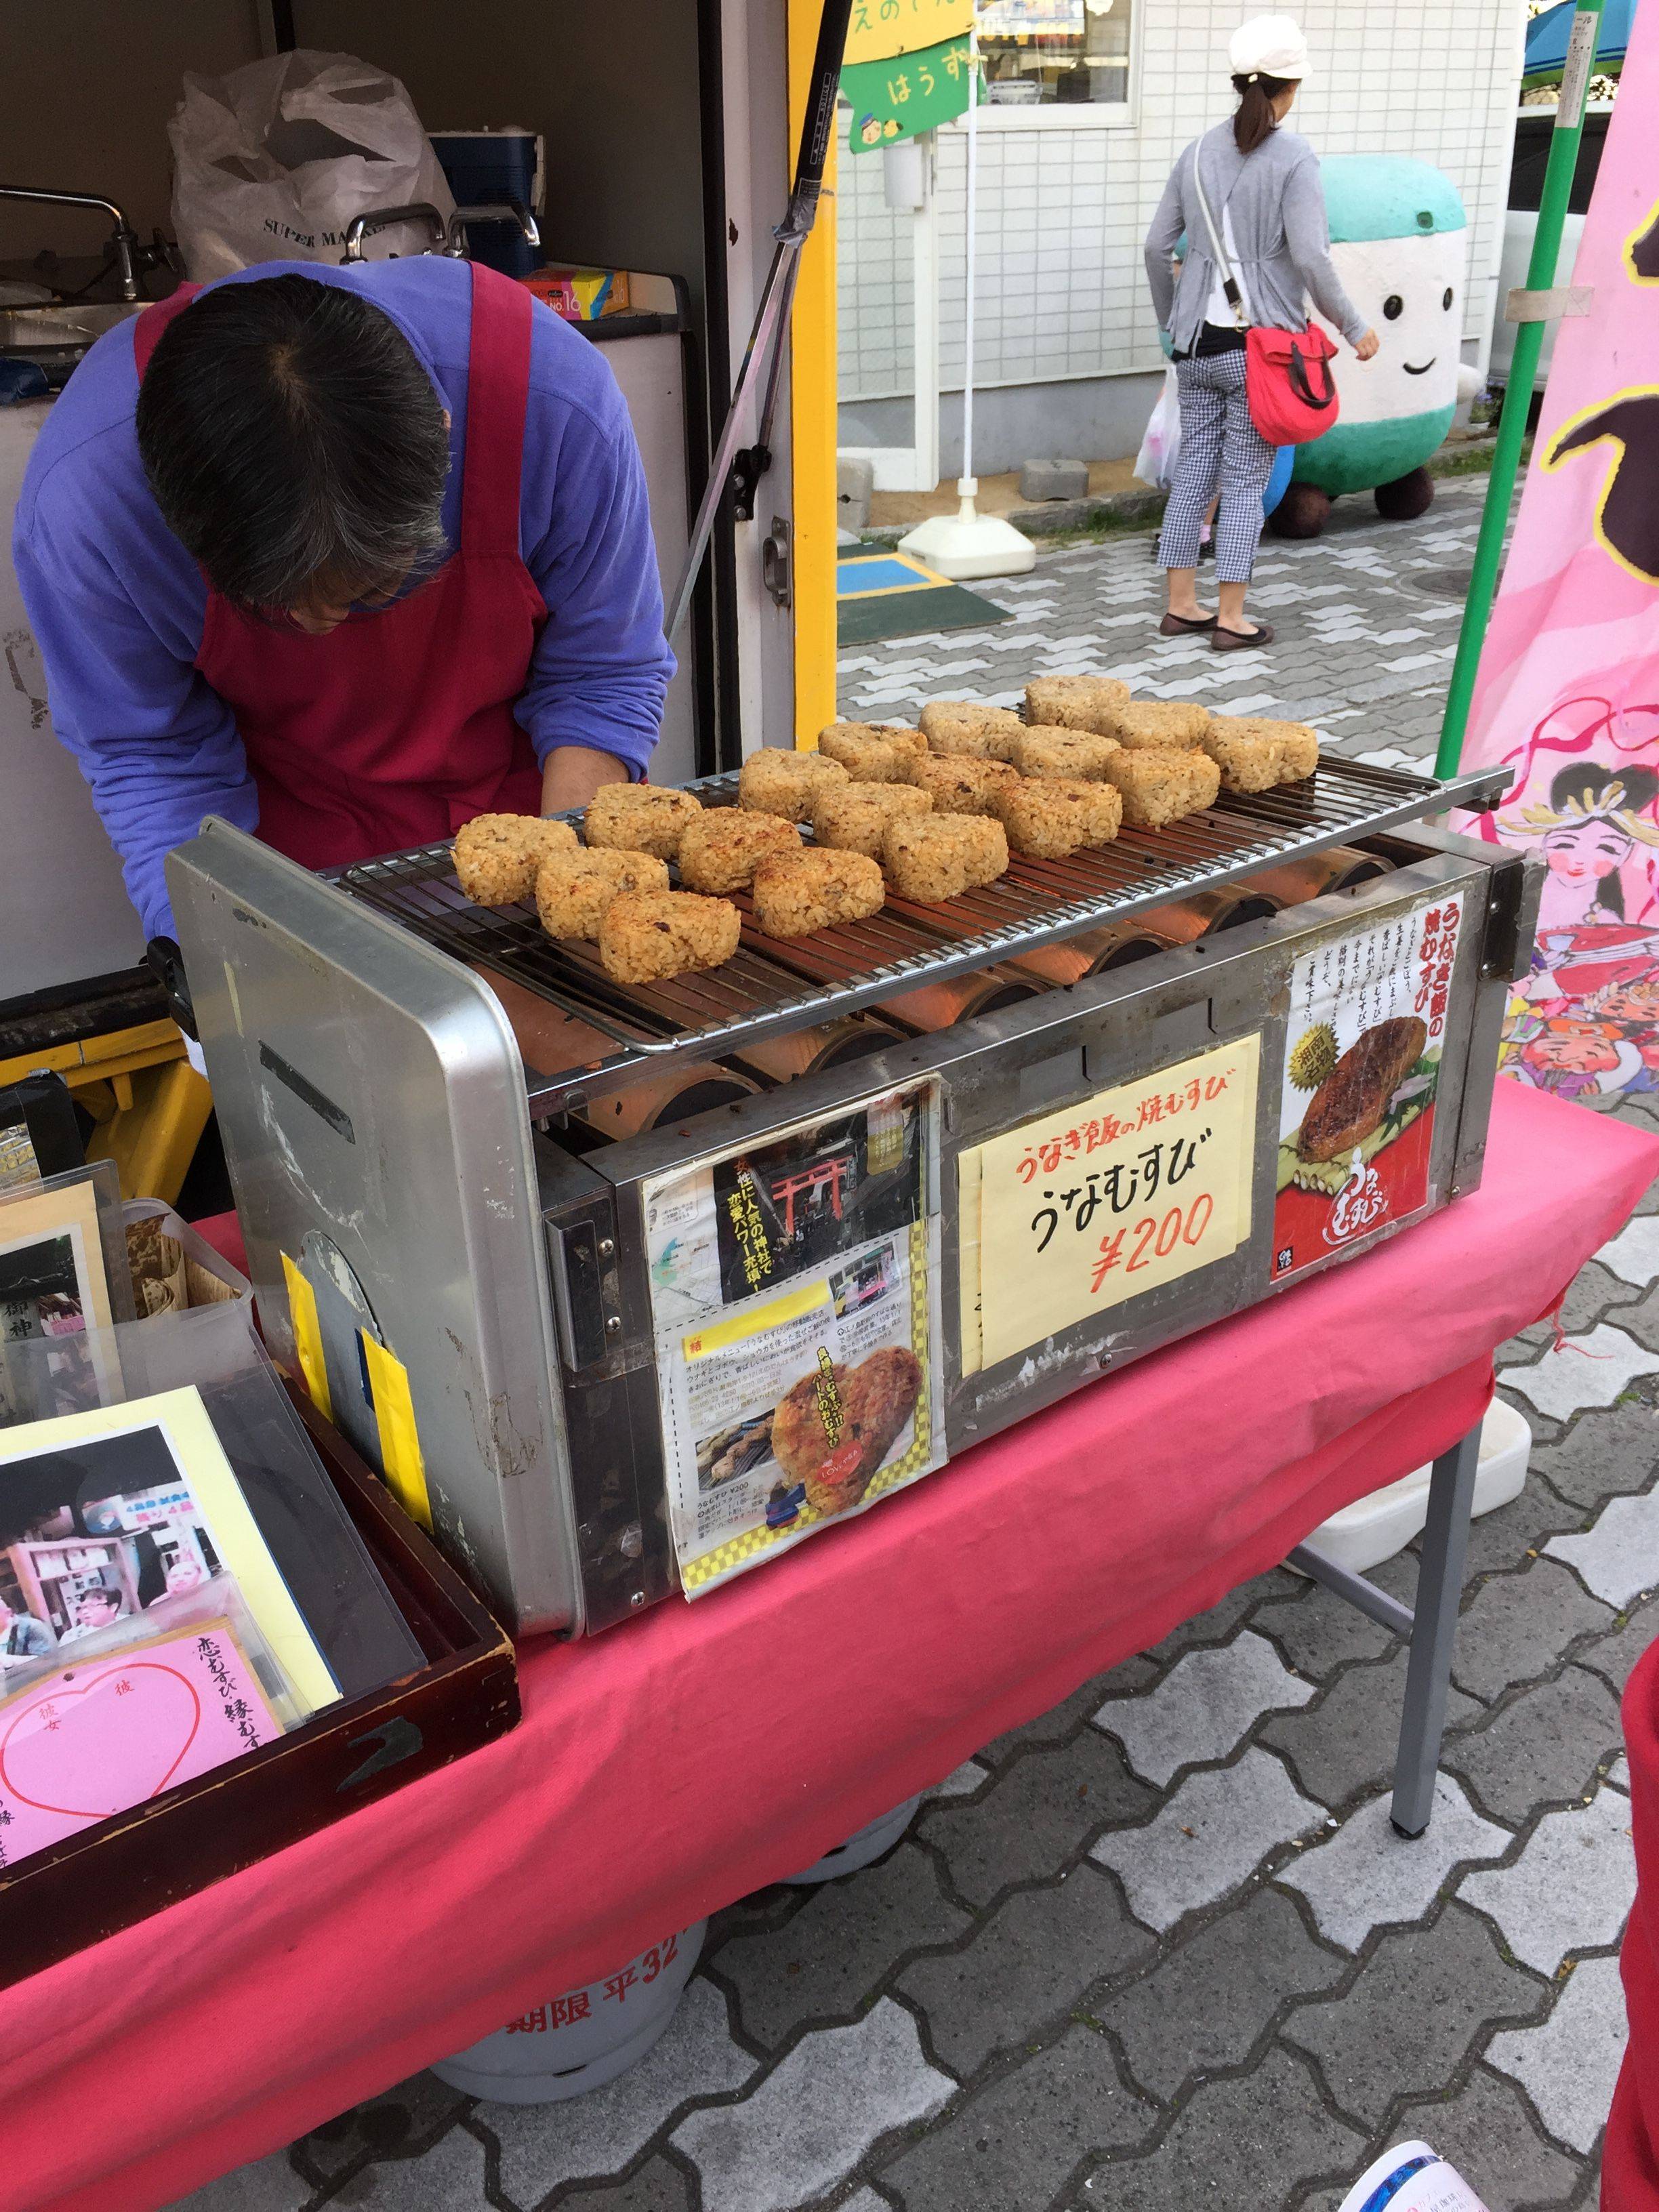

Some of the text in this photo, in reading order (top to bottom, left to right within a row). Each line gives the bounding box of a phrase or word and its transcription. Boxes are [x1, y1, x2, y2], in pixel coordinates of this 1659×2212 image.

[263, 219, 316, 249] SUPER
[1414, 908, 1442, 1014] 焼むすび
[1429, 902, 1461, 1038] うなぎ飯の
[1296, 1031, 1324, 1069] 湘南
[1304, 1046, 1331, 1080] 名物
[1015, 1067, 1237, 1185] うなぎ飯の焼むすび
[733, 1160, 774, 1275] 女性に人気の神社で
[1031, 1127, 1212, 1254] うなむすび
[1090, 1193, 1214, 1294] ¥200
[38, 1703, 62, 1732] 彼女
[115, 1679, 136, 1697] 彼
